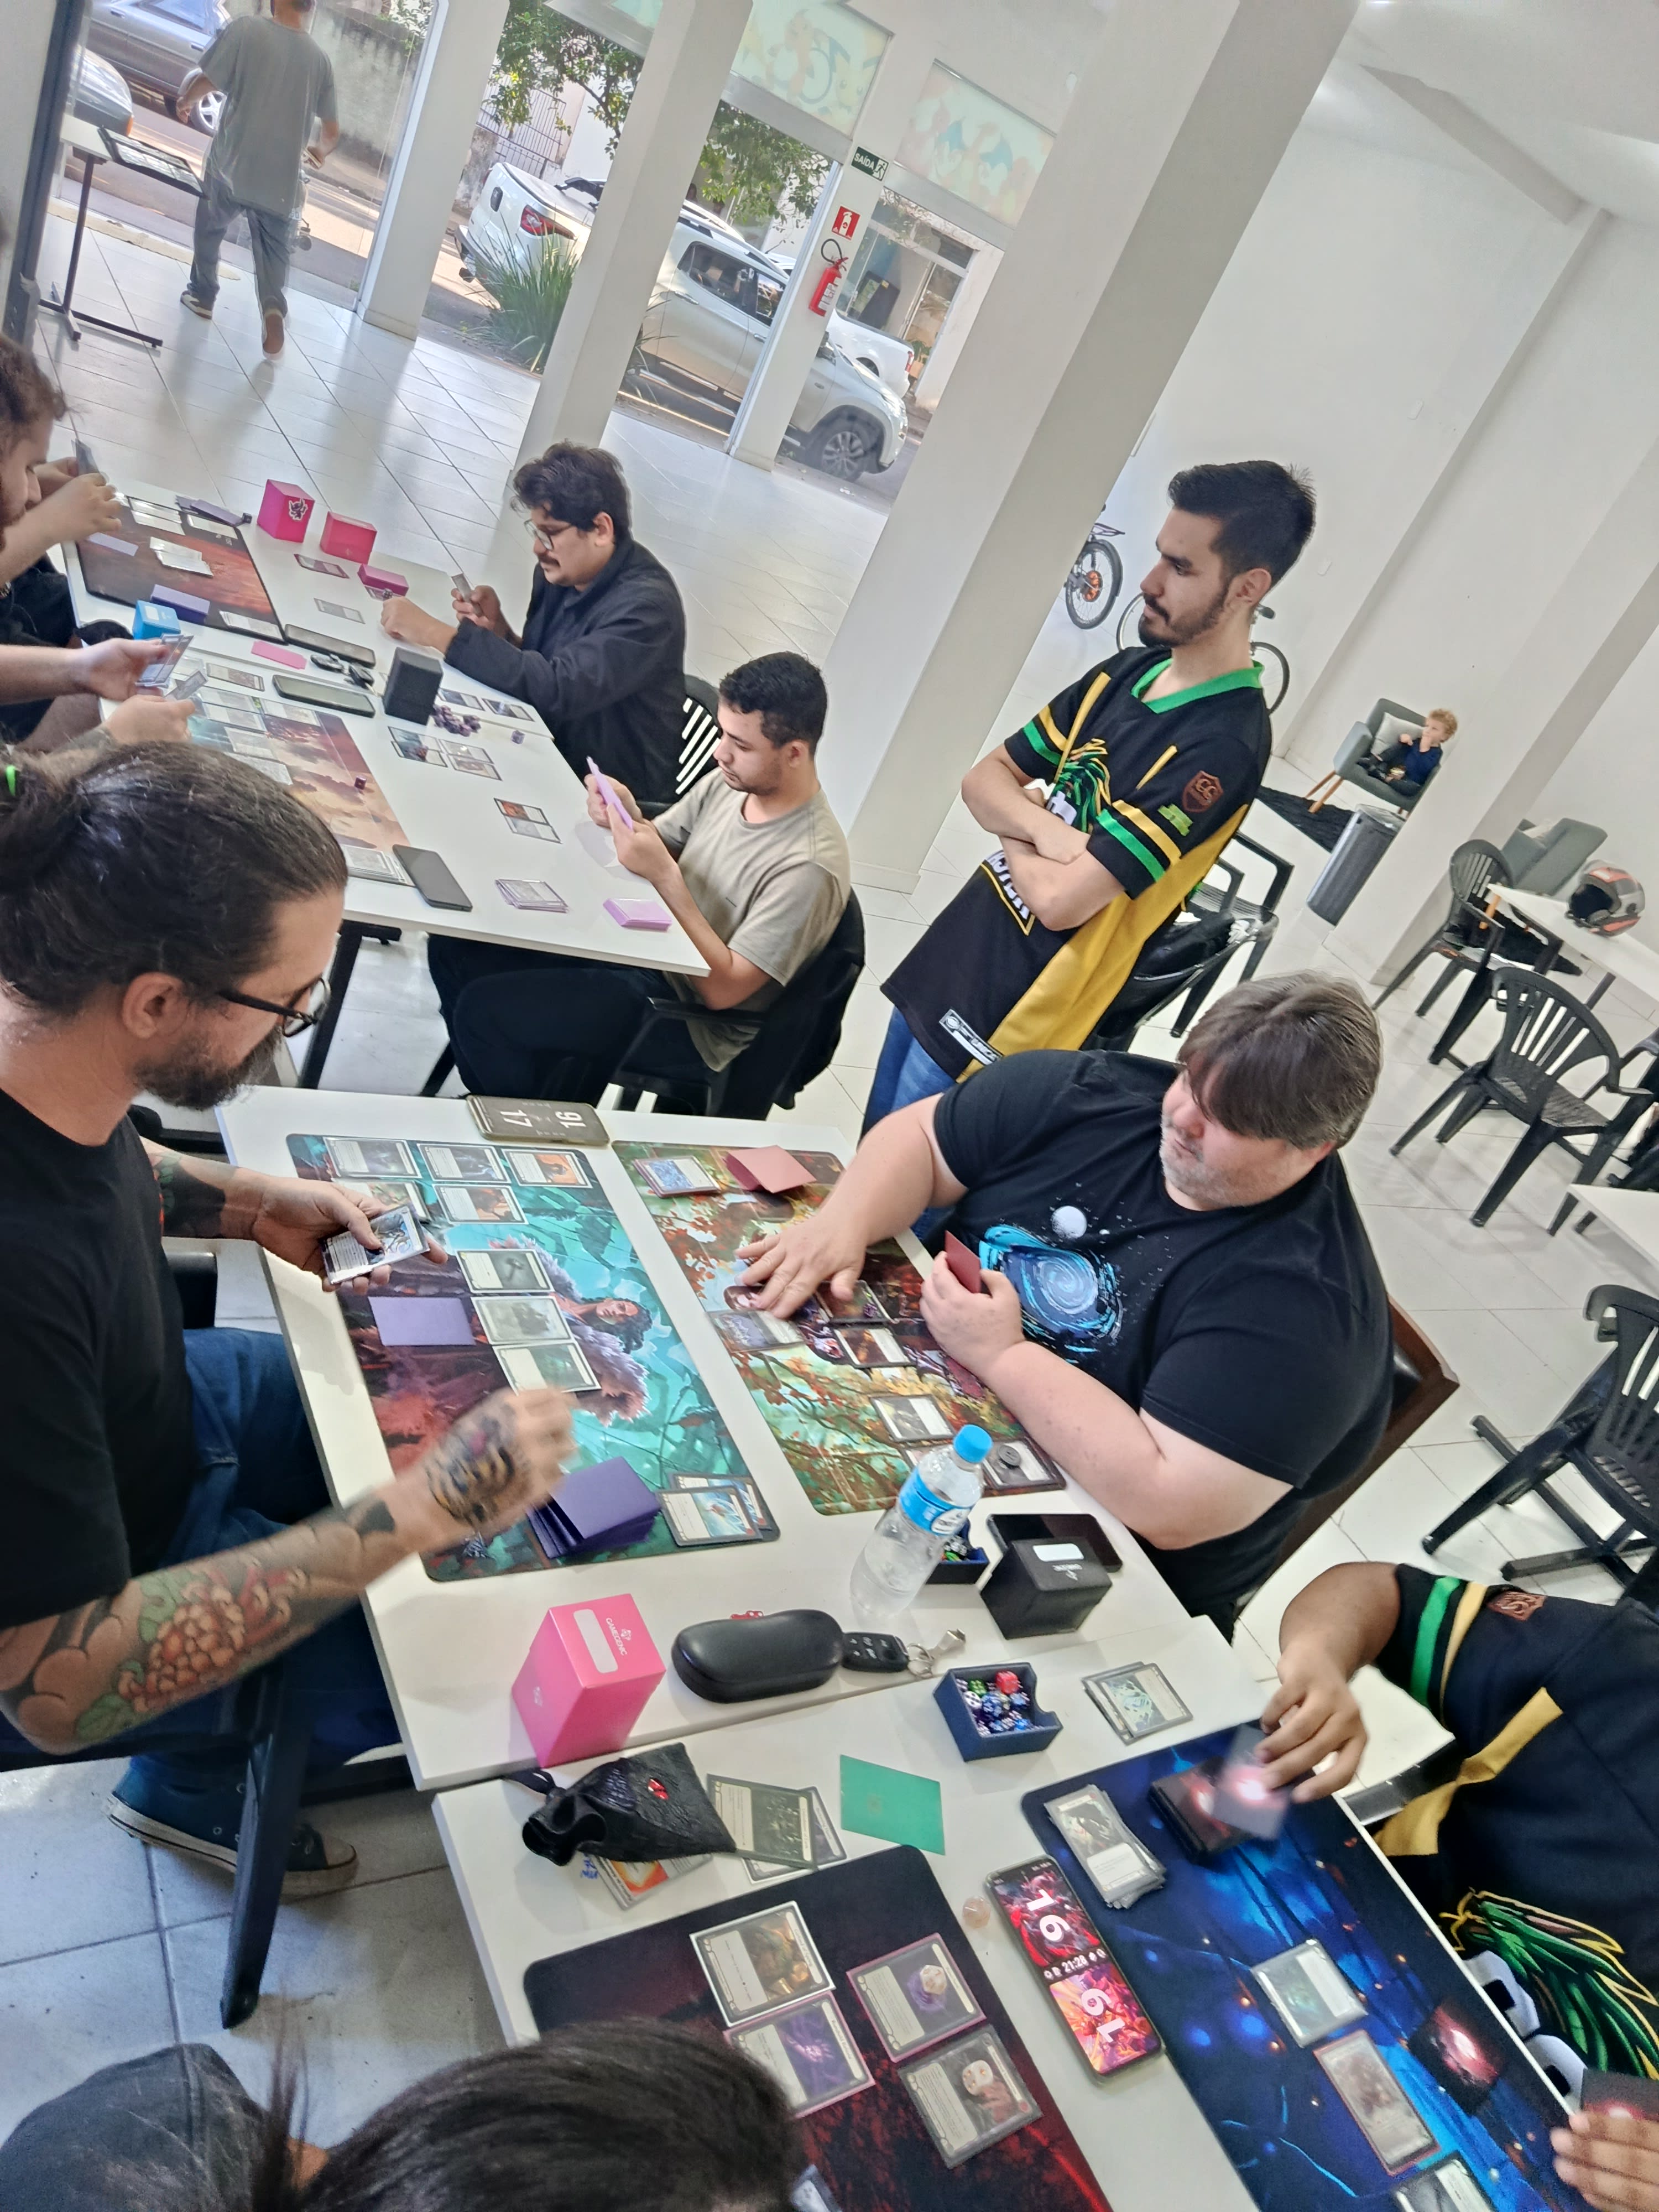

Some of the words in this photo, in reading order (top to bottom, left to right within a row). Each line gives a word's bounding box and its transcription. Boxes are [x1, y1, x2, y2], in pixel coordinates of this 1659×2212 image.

[854, 153, 875, 170] SAÍDA
[500, 1109, 533, 1127] 17
[555, 1111, 586, 1128] 16
[606, 1617, 628, 1656] GAMEGENIC
[1026, 1889, 1070, 1942] 16
[1062, 1955, 1088, 1973] 21:28
[1082, 1988, 1125, 2043] 19
